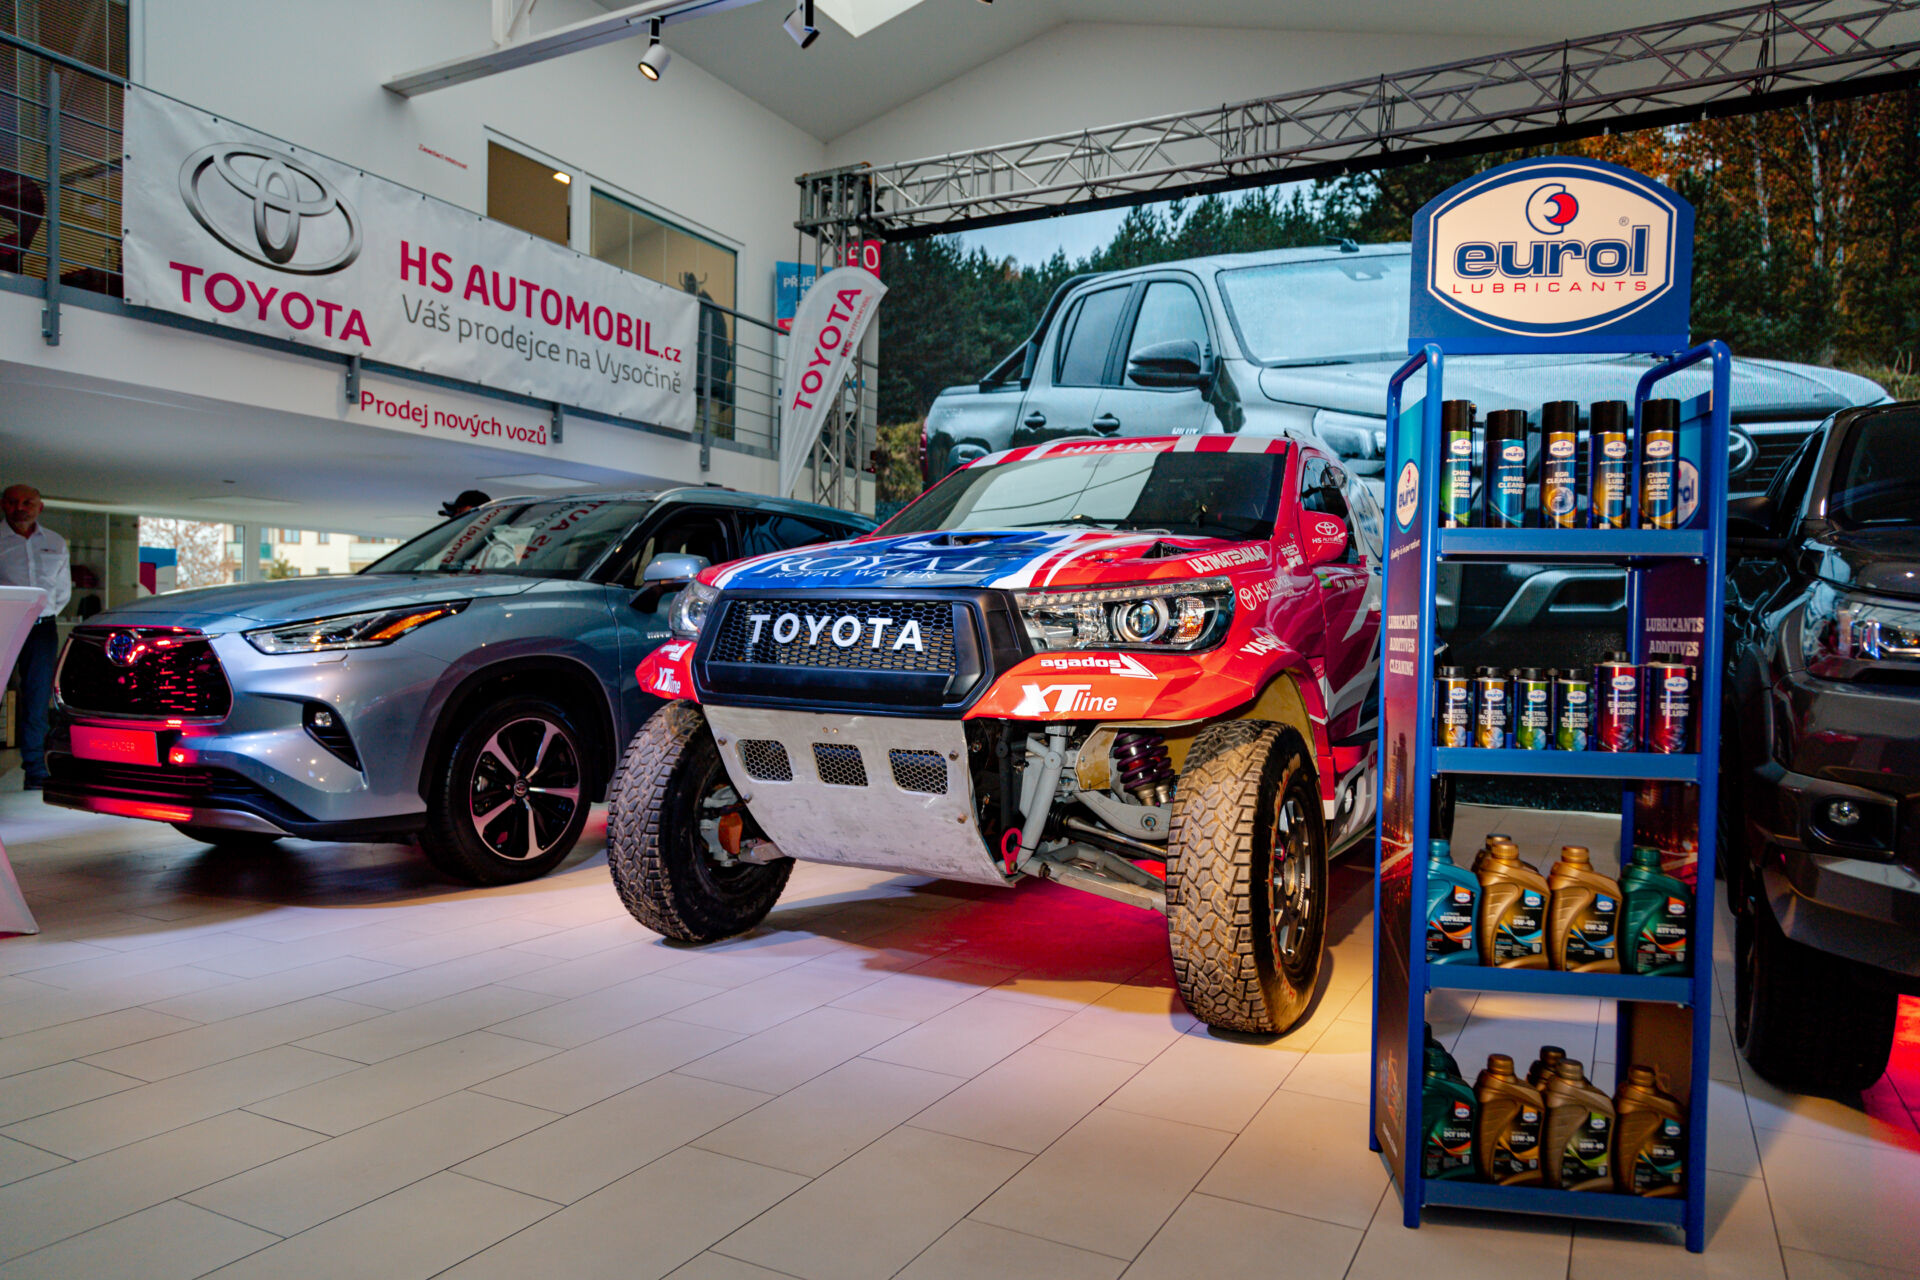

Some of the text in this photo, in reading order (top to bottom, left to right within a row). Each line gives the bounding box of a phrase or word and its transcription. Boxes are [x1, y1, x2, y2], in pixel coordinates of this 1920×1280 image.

[1453, 225, 1650, 280] eurol
[400, 240, 682, 364] HS AUTOMOBIL.cz
[1452, 281, 1648, 294] LUBRICANTS
[169, 261, 372, 347] TOYOTA
[402, 294, 682, 395] Váš prodejce na Vysočině
[792, 289, 863, 411] TOYOTA
[361, 390, 547, 446] Prodej nových vozů
[1061, 442, 1161, 455] HILUX
[1397, 479, 1417, 508] eurol
[768, 569, 938, 580] ROYAL WATER
[1252, 582, 1270, 603] HS
[749, 613, 923, 653] TOYOTA
[1645, 617, 1704, 633] LUBRICANTS
[1648, 640, 1700, 657] ADDITIVES
[1040, 658, 1121, 670] agados
[1012, 684, 1118, 715] XTline
